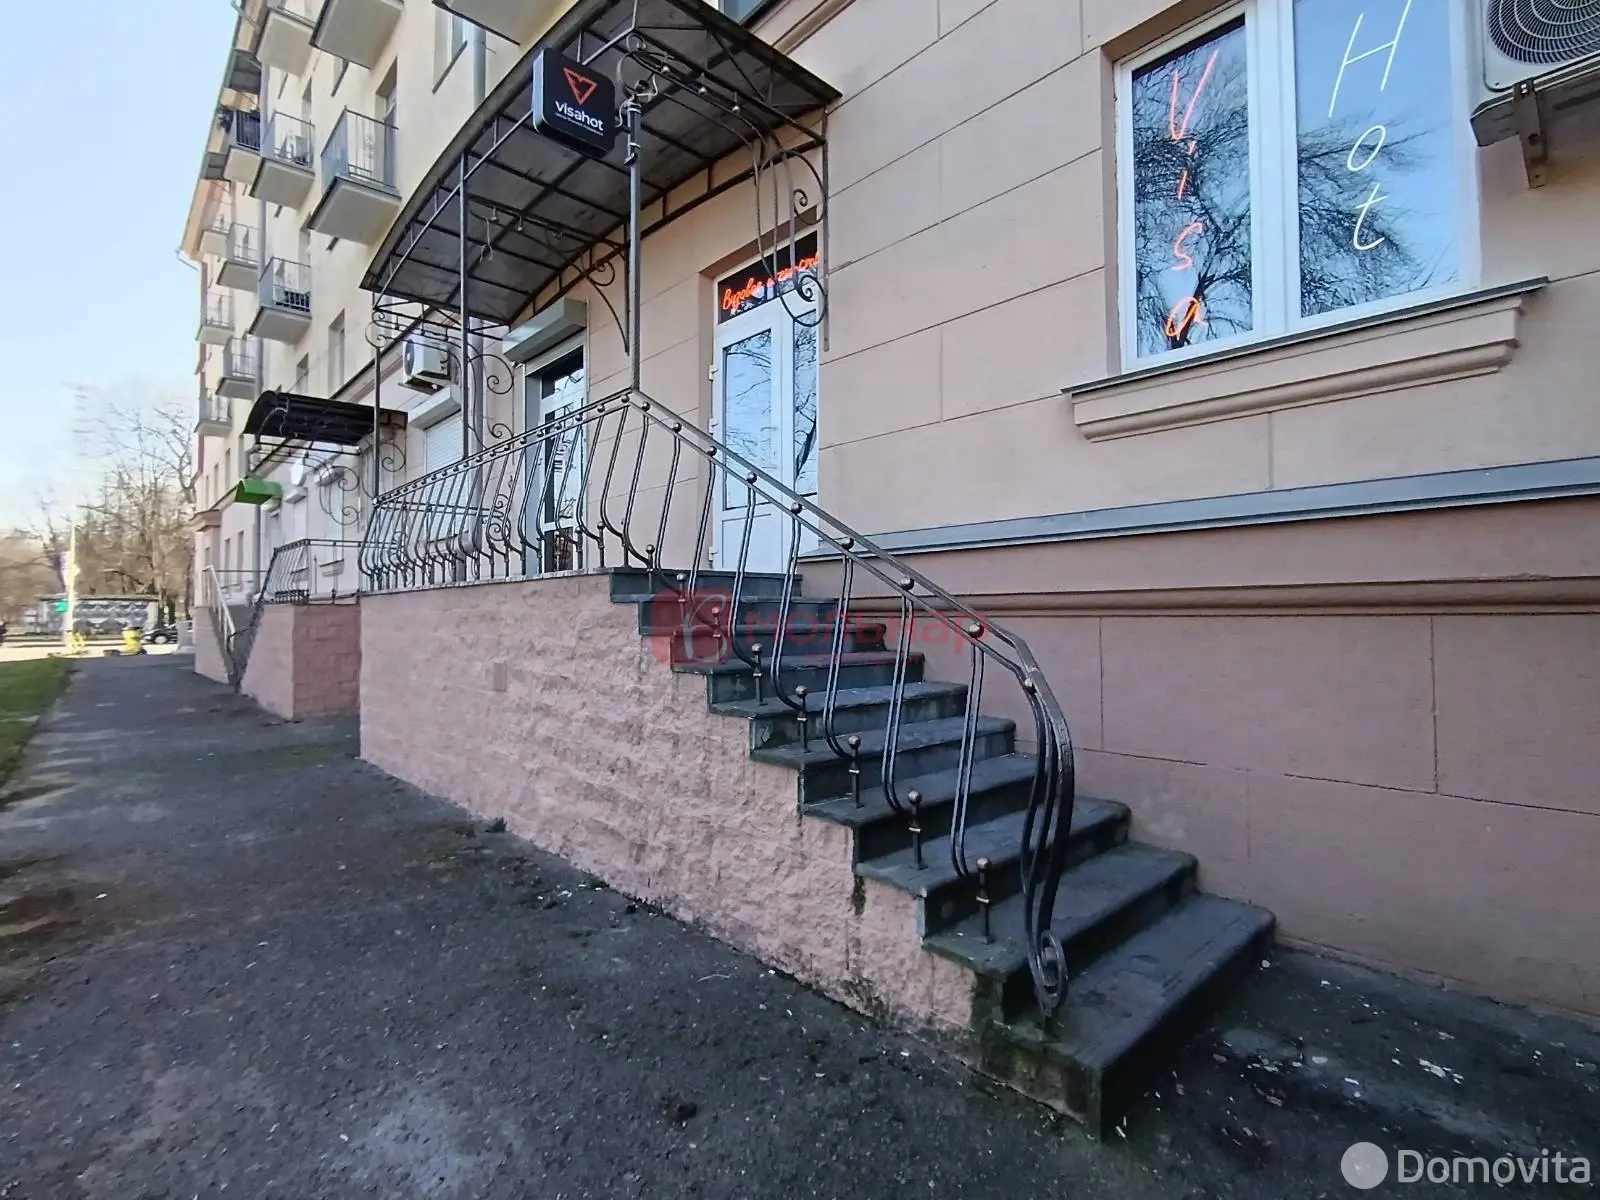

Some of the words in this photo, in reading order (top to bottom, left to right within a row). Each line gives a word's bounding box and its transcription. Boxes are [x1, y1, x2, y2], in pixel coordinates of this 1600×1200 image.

[555, 100, 604, 131] visahot
[1164, 49, 1219, 340] Visa
[1329, 0, 1413, 252] Hot
